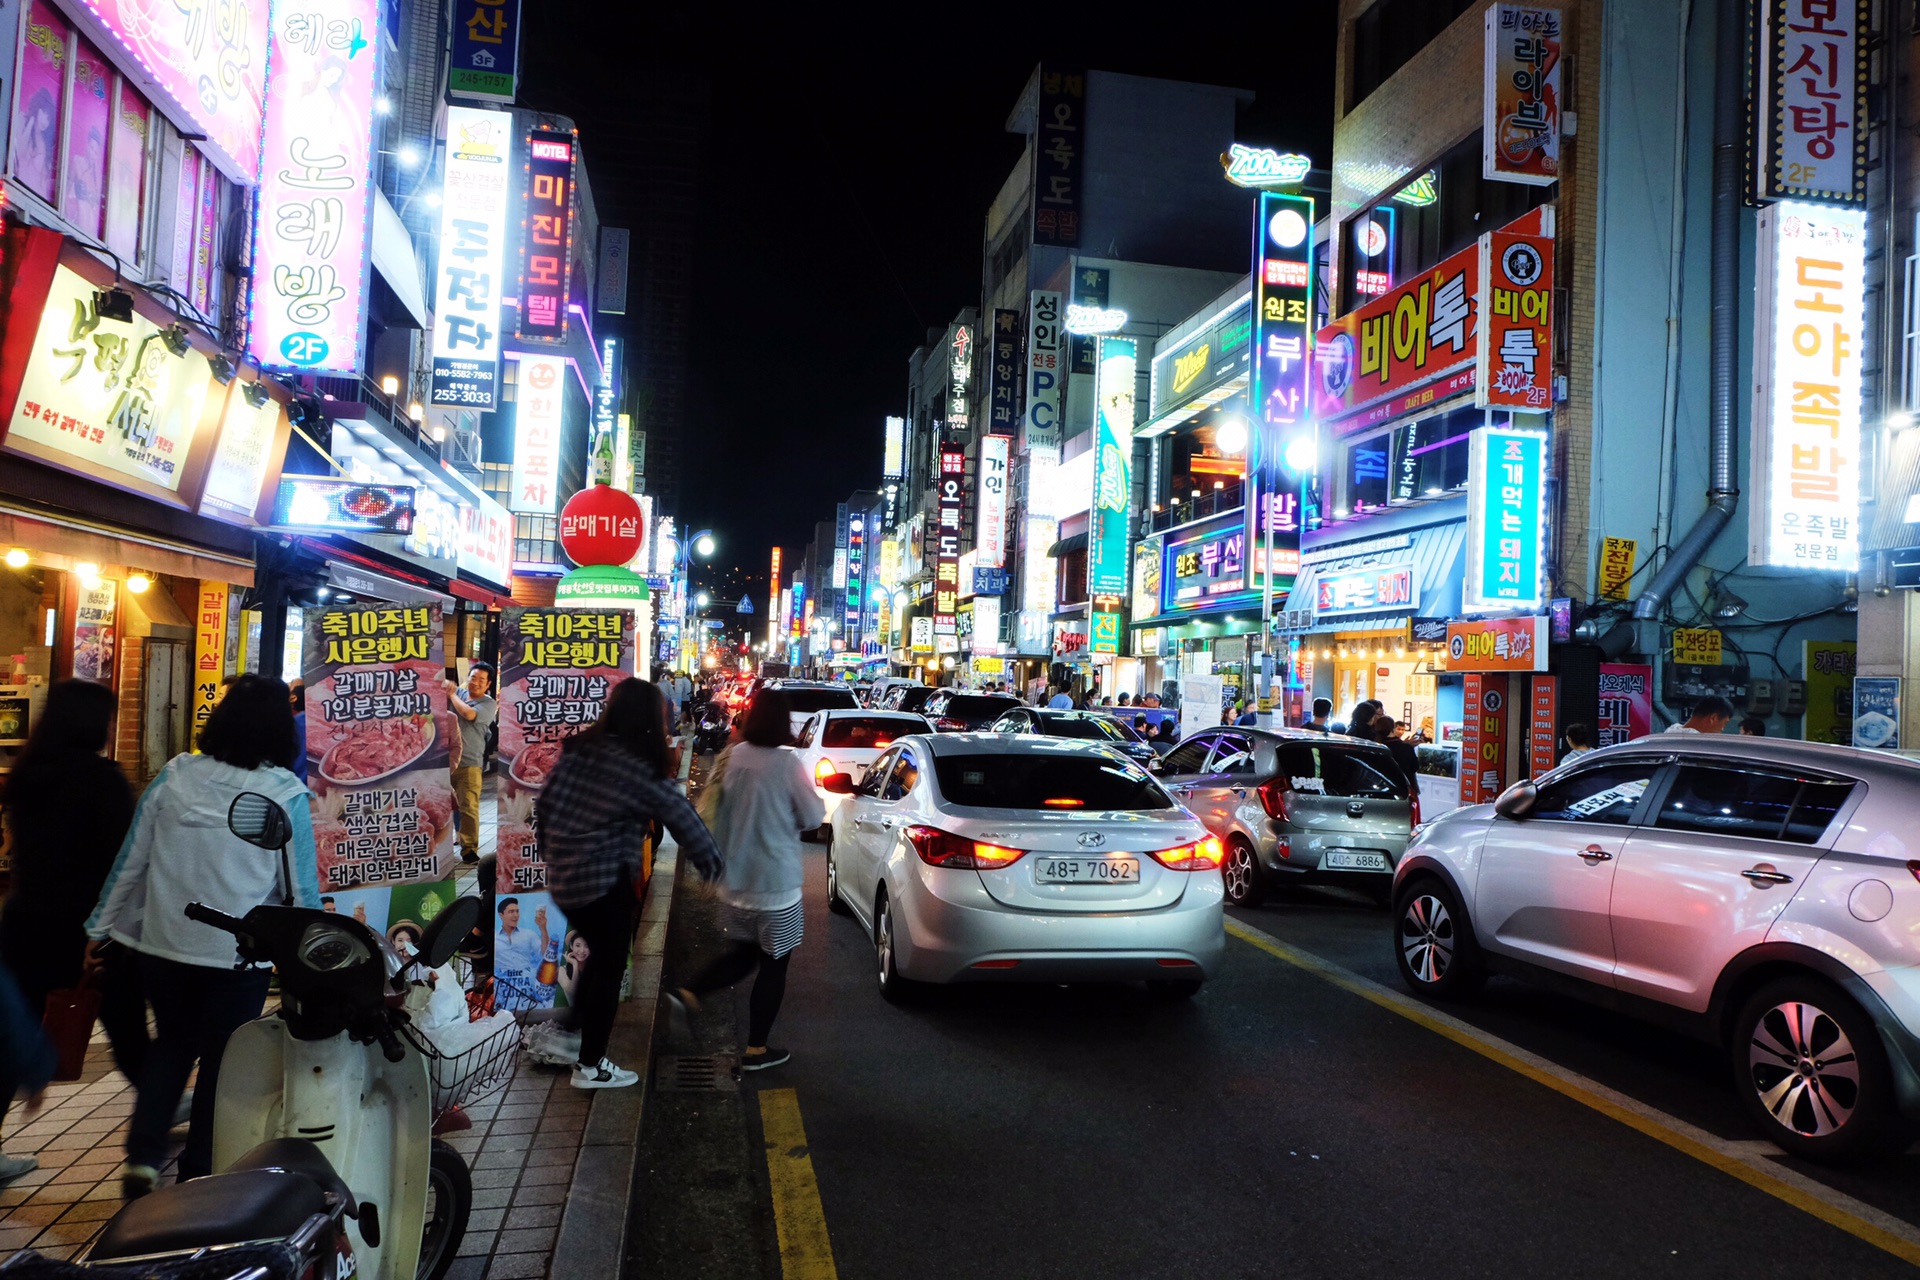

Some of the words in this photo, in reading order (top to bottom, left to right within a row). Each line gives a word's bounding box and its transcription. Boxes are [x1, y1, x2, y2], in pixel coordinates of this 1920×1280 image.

[283, 12, 367, 60] 헤라
[1502, 10, 1559, 36] 피아노
[475, 54, 492, 65] 3F
[459, 72, 506, 88] 245-1757
[1511, 38, 1548, 130] 라이브
[532, 143, 570, 160] MOTEL
[448, 170, 504, 192] 꽃삼겹살
[1788, 162, 1816, 183] 2F
[274, 136, 355, 326] 노래방
[527, 174, 563, 328] 미진모텔
[444, 218, 493, 351] 주전자
[1264, 297, 1306, 323] 원조
[1493, 287, 1550, 327] 비어
[1034, 296, 1058, 351] 성인
[1360, 268, 1471, 386] 비어톡
[287, 334, 325, 360] 2F
[1032, 353, 1057, 369] 전용
[1499, 328, 1539, 374] 톡
[435, 368, 493, 380] 010-5582-7963
[1791, 256, 1850, 502] 도야족발
[434, 388, 492, 403] 255-3033
[1030, 371, 1055, 429] PC
[1528, 386, 1546, 403] 2F
[985, 457, 1005, 494] 가인
[1501, 440, 1524, 532] 조개먹는
[562, 514, 638, 538] 갈매기살
[940, 480, 961, 557] 오륙도
[1780, 512, 1850, 541] 온족발
[1202, 534, 1242, 577] 부산
[1607, 538, 1634, 552] 국제
[1793, 542, 1839, 561] 전문점
[1175, 552, 1197, 578] 원조
[1499, 538, 1521, 584] 돼지
[937, 562, 958, 613] 족발
[975, 577, 1005, 592] 치과
[199, 592, 224, 671] 갈매기살
[321, 609, 430, 638] 축10주년
[519, 613, 622, 641] 축10주년
[324, 636, 429, 665] 사은행사
[519, 639, 620, 667] 사은행사
[1467, 631, 1509, 661] 비어톡
[1685, 632, 1720, 652] 전당포
[333, 669, 420, 697] 갈매기살
[526, 674, 607, 699] 갈매기살
[322, 693, 431, 722] 1인분공짜!!
[1480, 715, 1500, 794] 비어톡
[343, 788, 418, 811] 갈매기살
[343, 811, 420, 836] 생삼겹살
[335, 833, 430, 861] 매운삼겹살
[1355, 855, 1381, 867] 6886
[327, 855, 439, 886] 돼지양념갈비
[1046, 862, 1080, 881] 48구
[1087, 862, 1131, 880] 7062
[499, 976, 531, 989] EXTRA
[507, 968, 524, 978] hite
